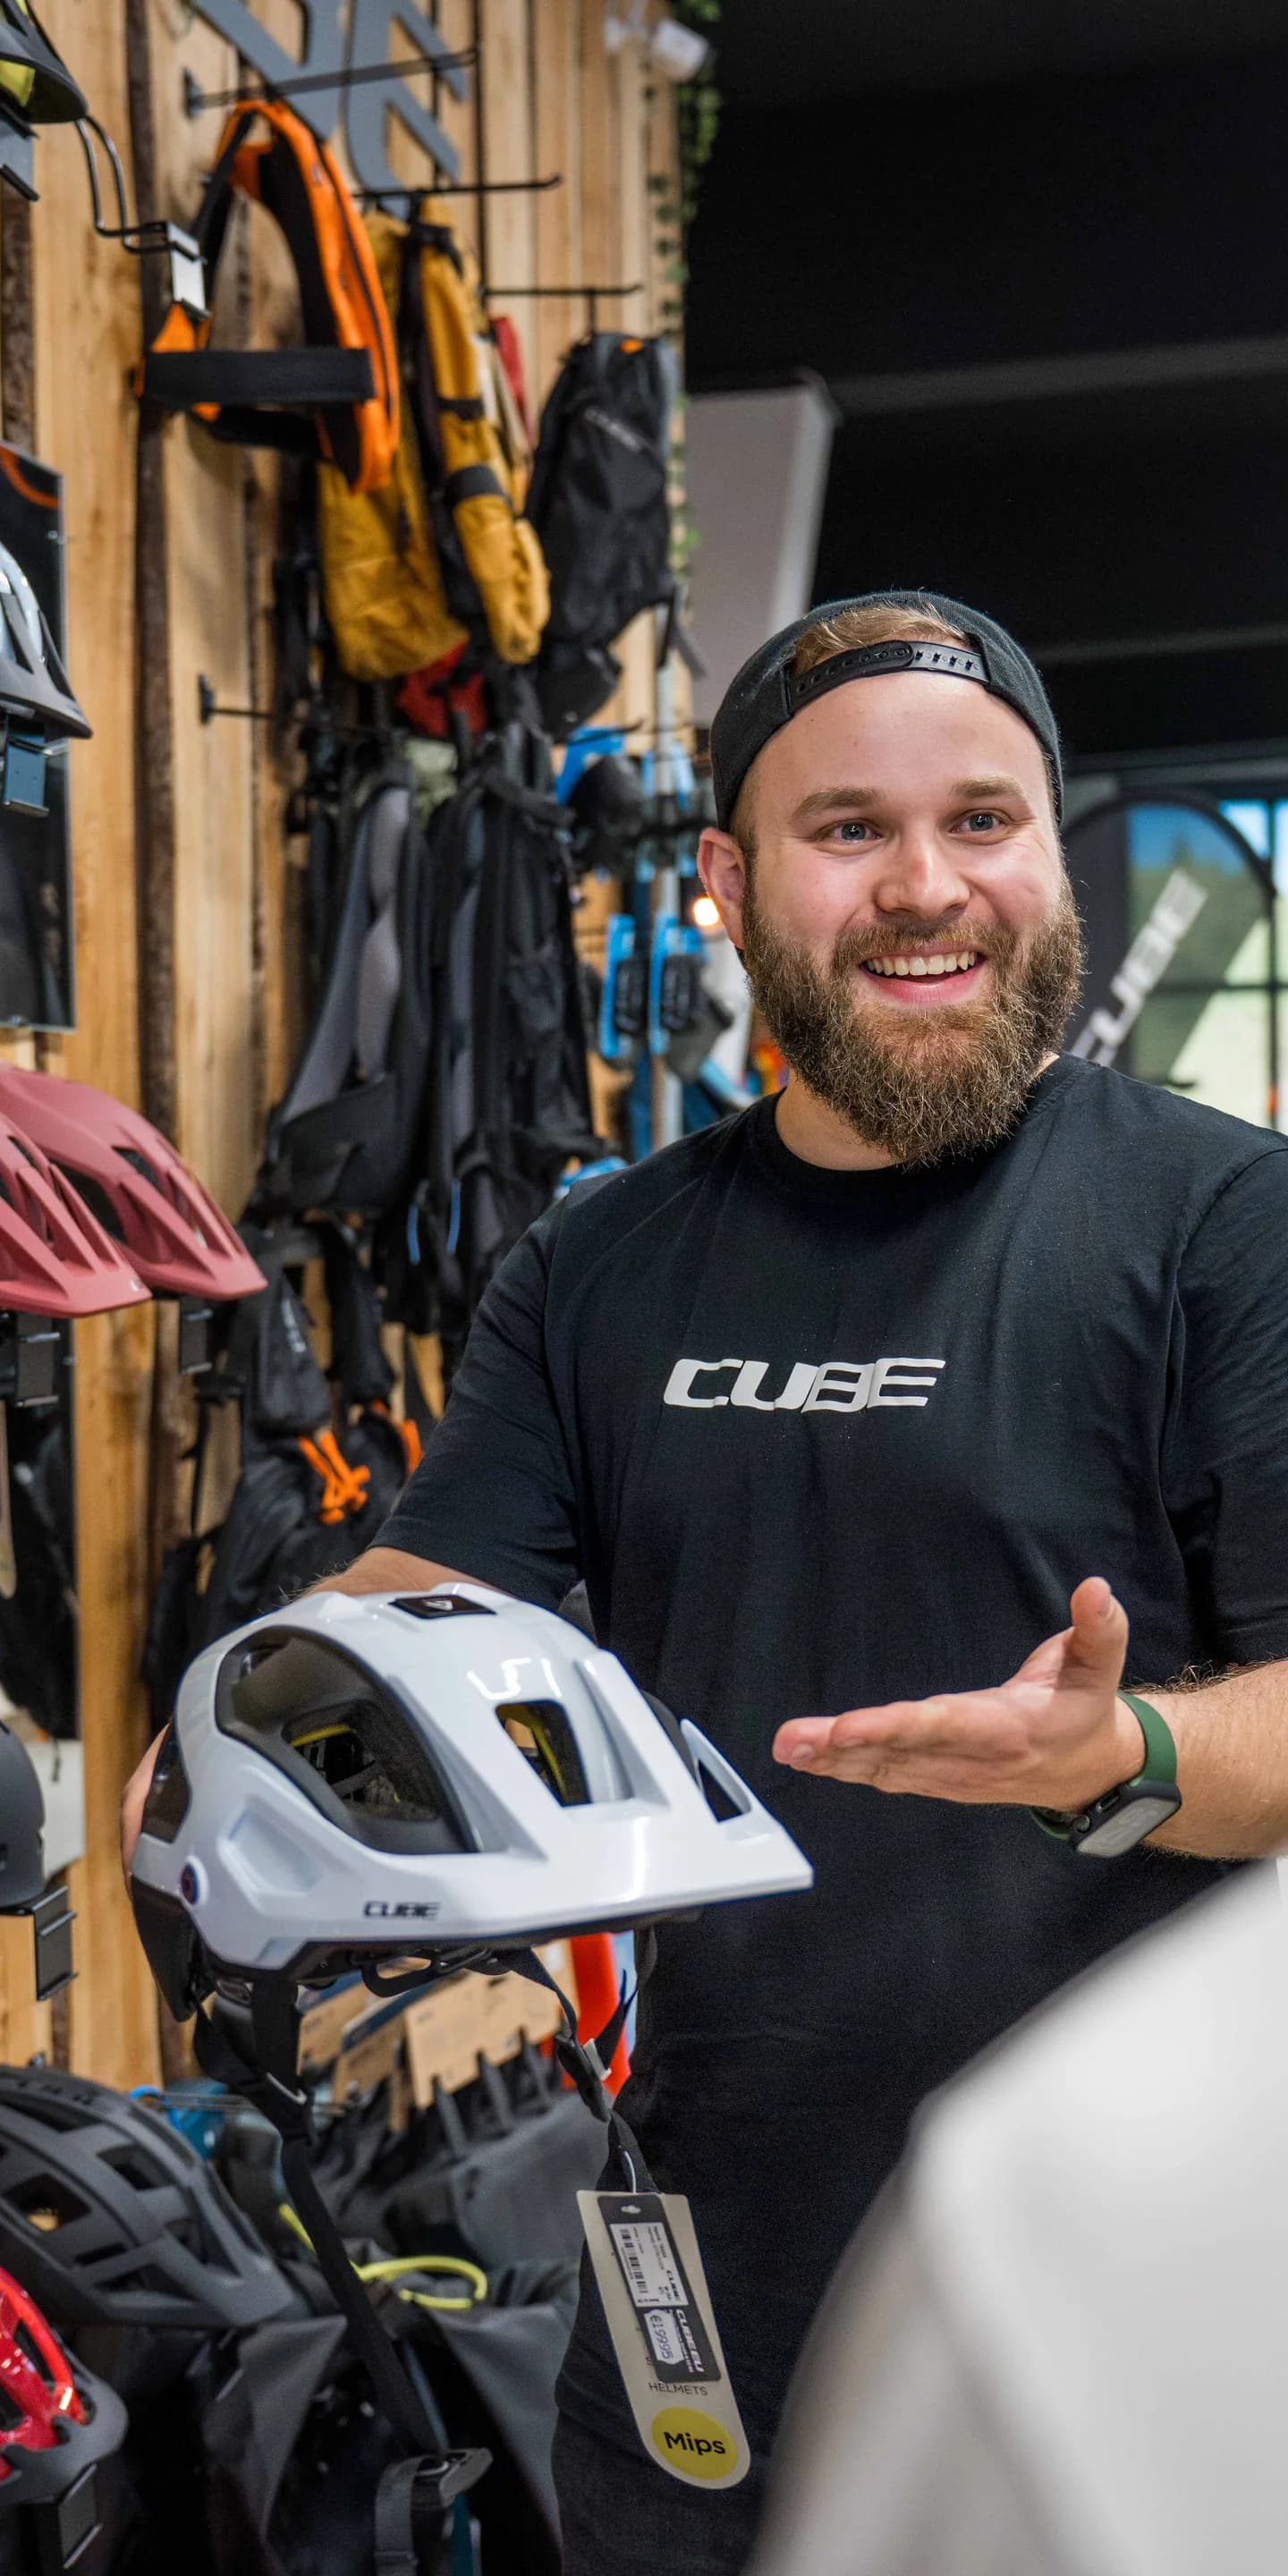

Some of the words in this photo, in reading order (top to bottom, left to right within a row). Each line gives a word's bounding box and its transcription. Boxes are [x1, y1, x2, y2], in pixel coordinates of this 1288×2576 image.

[663, 1358, 945, 1413] CUBE
[648, 2382, 708, 2396] HELMETS
[664, 2431, 726, 2456] Mips
